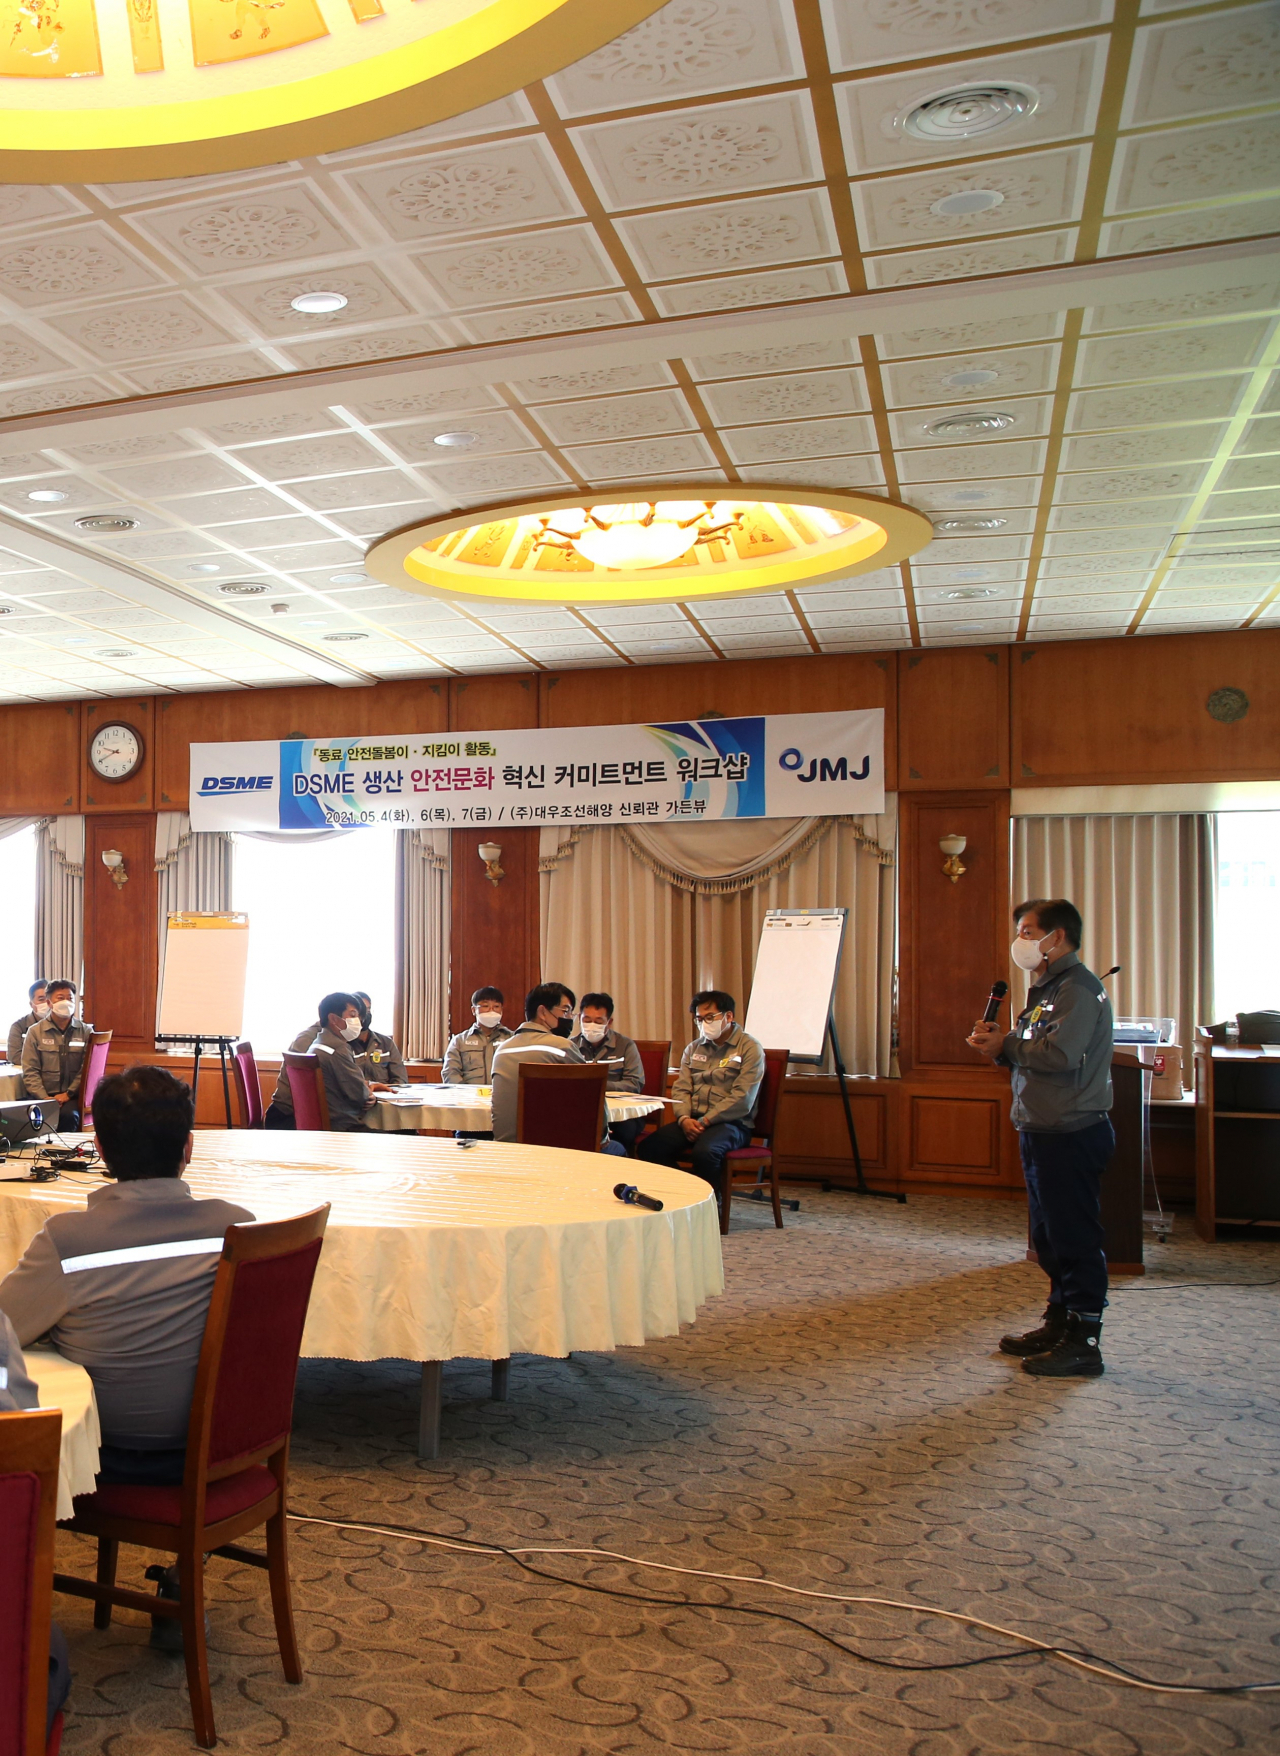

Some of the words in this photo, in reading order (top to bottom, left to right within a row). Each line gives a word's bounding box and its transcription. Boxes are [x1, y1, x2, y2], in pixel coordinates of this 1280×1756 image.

[104, 732, 110, 740] 11
[128, 737, 132, 745] 2
[347, 745, 409, 761] 안전돌봄이
[422, 743, 460, 758] 지킴이
[104, 765, 109, 773] 7
[121, 764, 126, 772] 5
[294, 773, 355, 795] DSME
[362, 770, 404, 794] 생산
[410, 766, 495, 793] 안전문화
[502, 765, 546, 790] 혁신
[554, 760, 668, 788] 커미트먼트
[676, 753, 749, 782] 워크샵
[201, 776, 274, 790] DSME
[326, 808, 415, 824] 2021.05.4(화),
[420, 807, 456, 822] 6(목),
[461, 806, 493, 821] 7(금)
[498, 806, 505, 821] /
[510, 803, 613, 820] (주)대우조선해양
[619, 801, 660, 816] 신뢰관
[666, 799, 707, 814] 가든뷰
